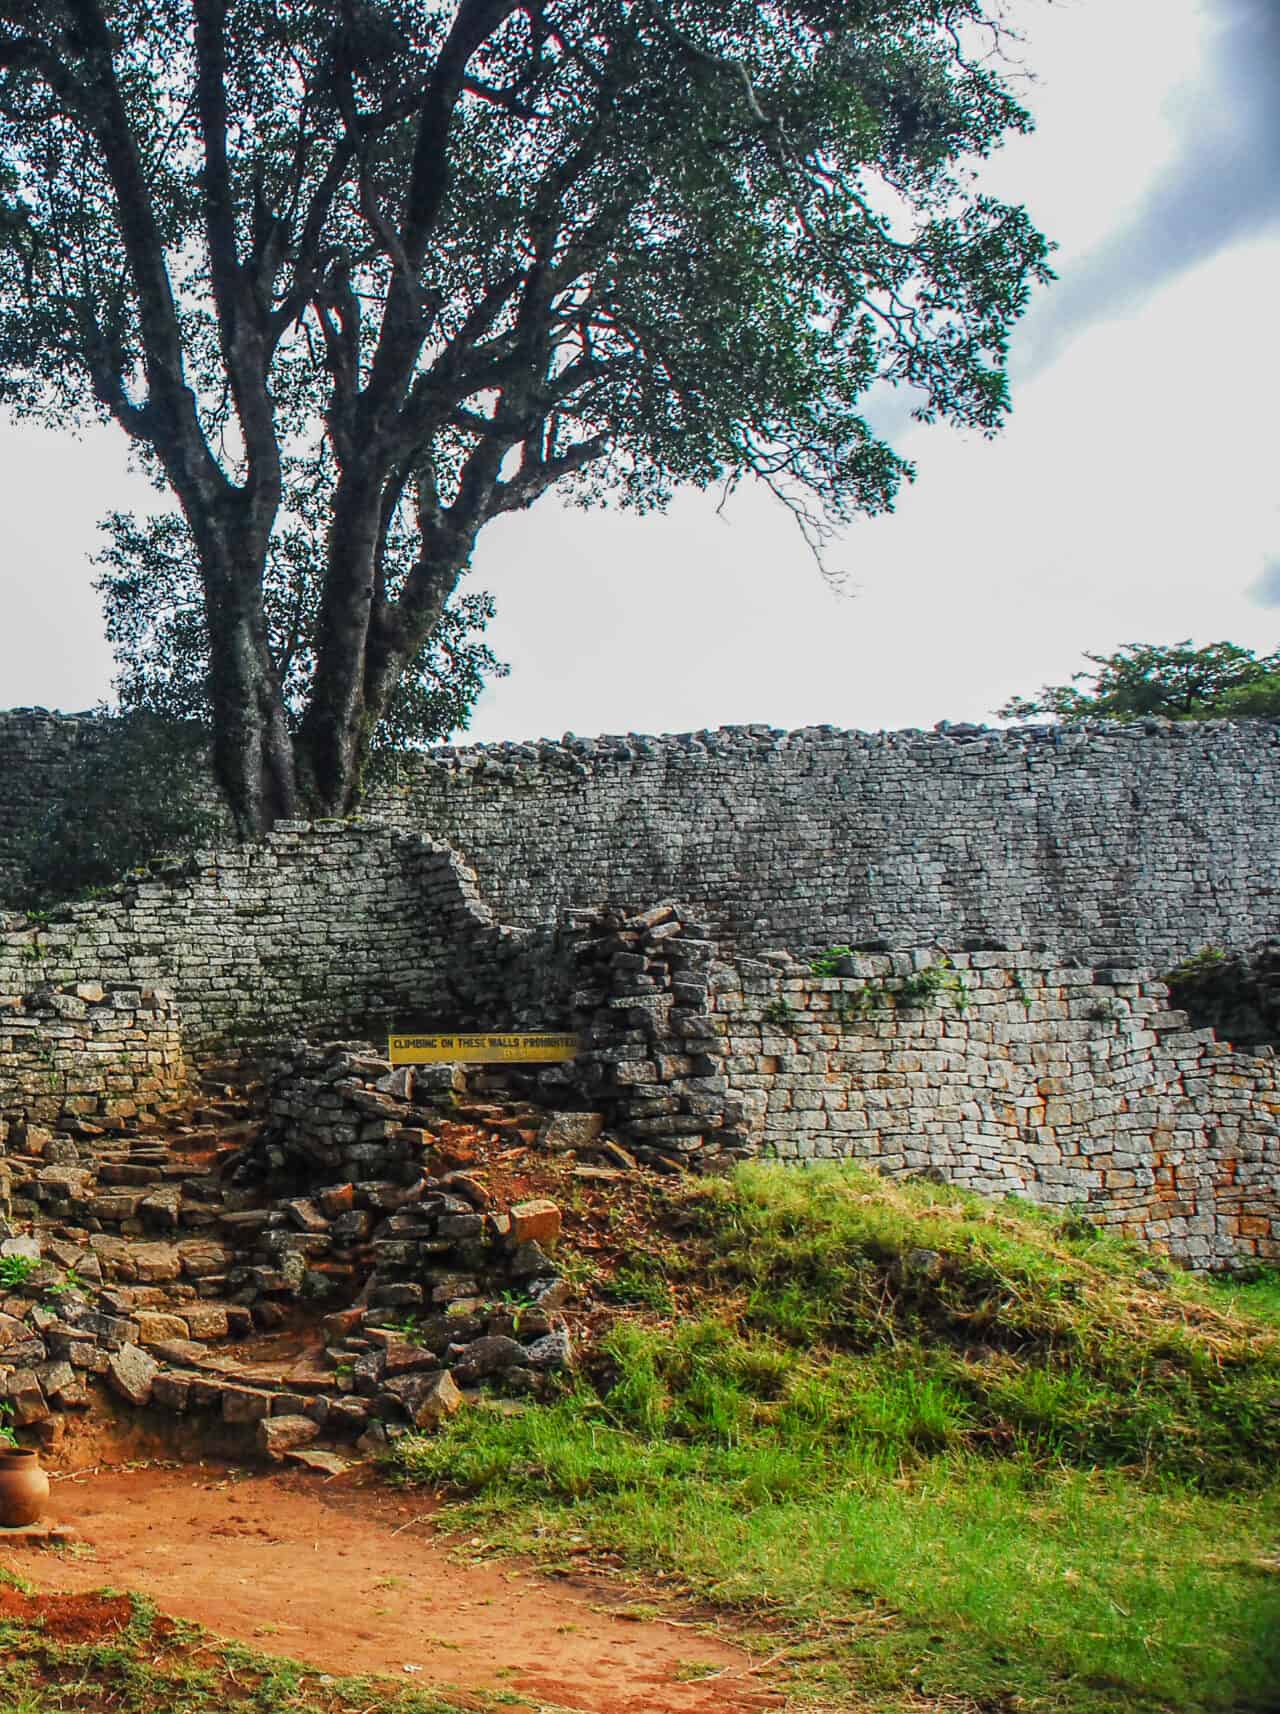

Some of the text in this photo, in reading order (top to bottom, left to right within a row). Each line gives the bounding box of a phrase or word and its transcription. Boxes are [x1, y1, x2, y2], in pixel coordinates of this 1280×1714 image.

[394, 1039, 437, 1049] CLIMBING
[441, 1039, 454, 1049] ON
[458, 1038, 488, 1049] THESE
[489, 1038, 520, 1048] WALLS
